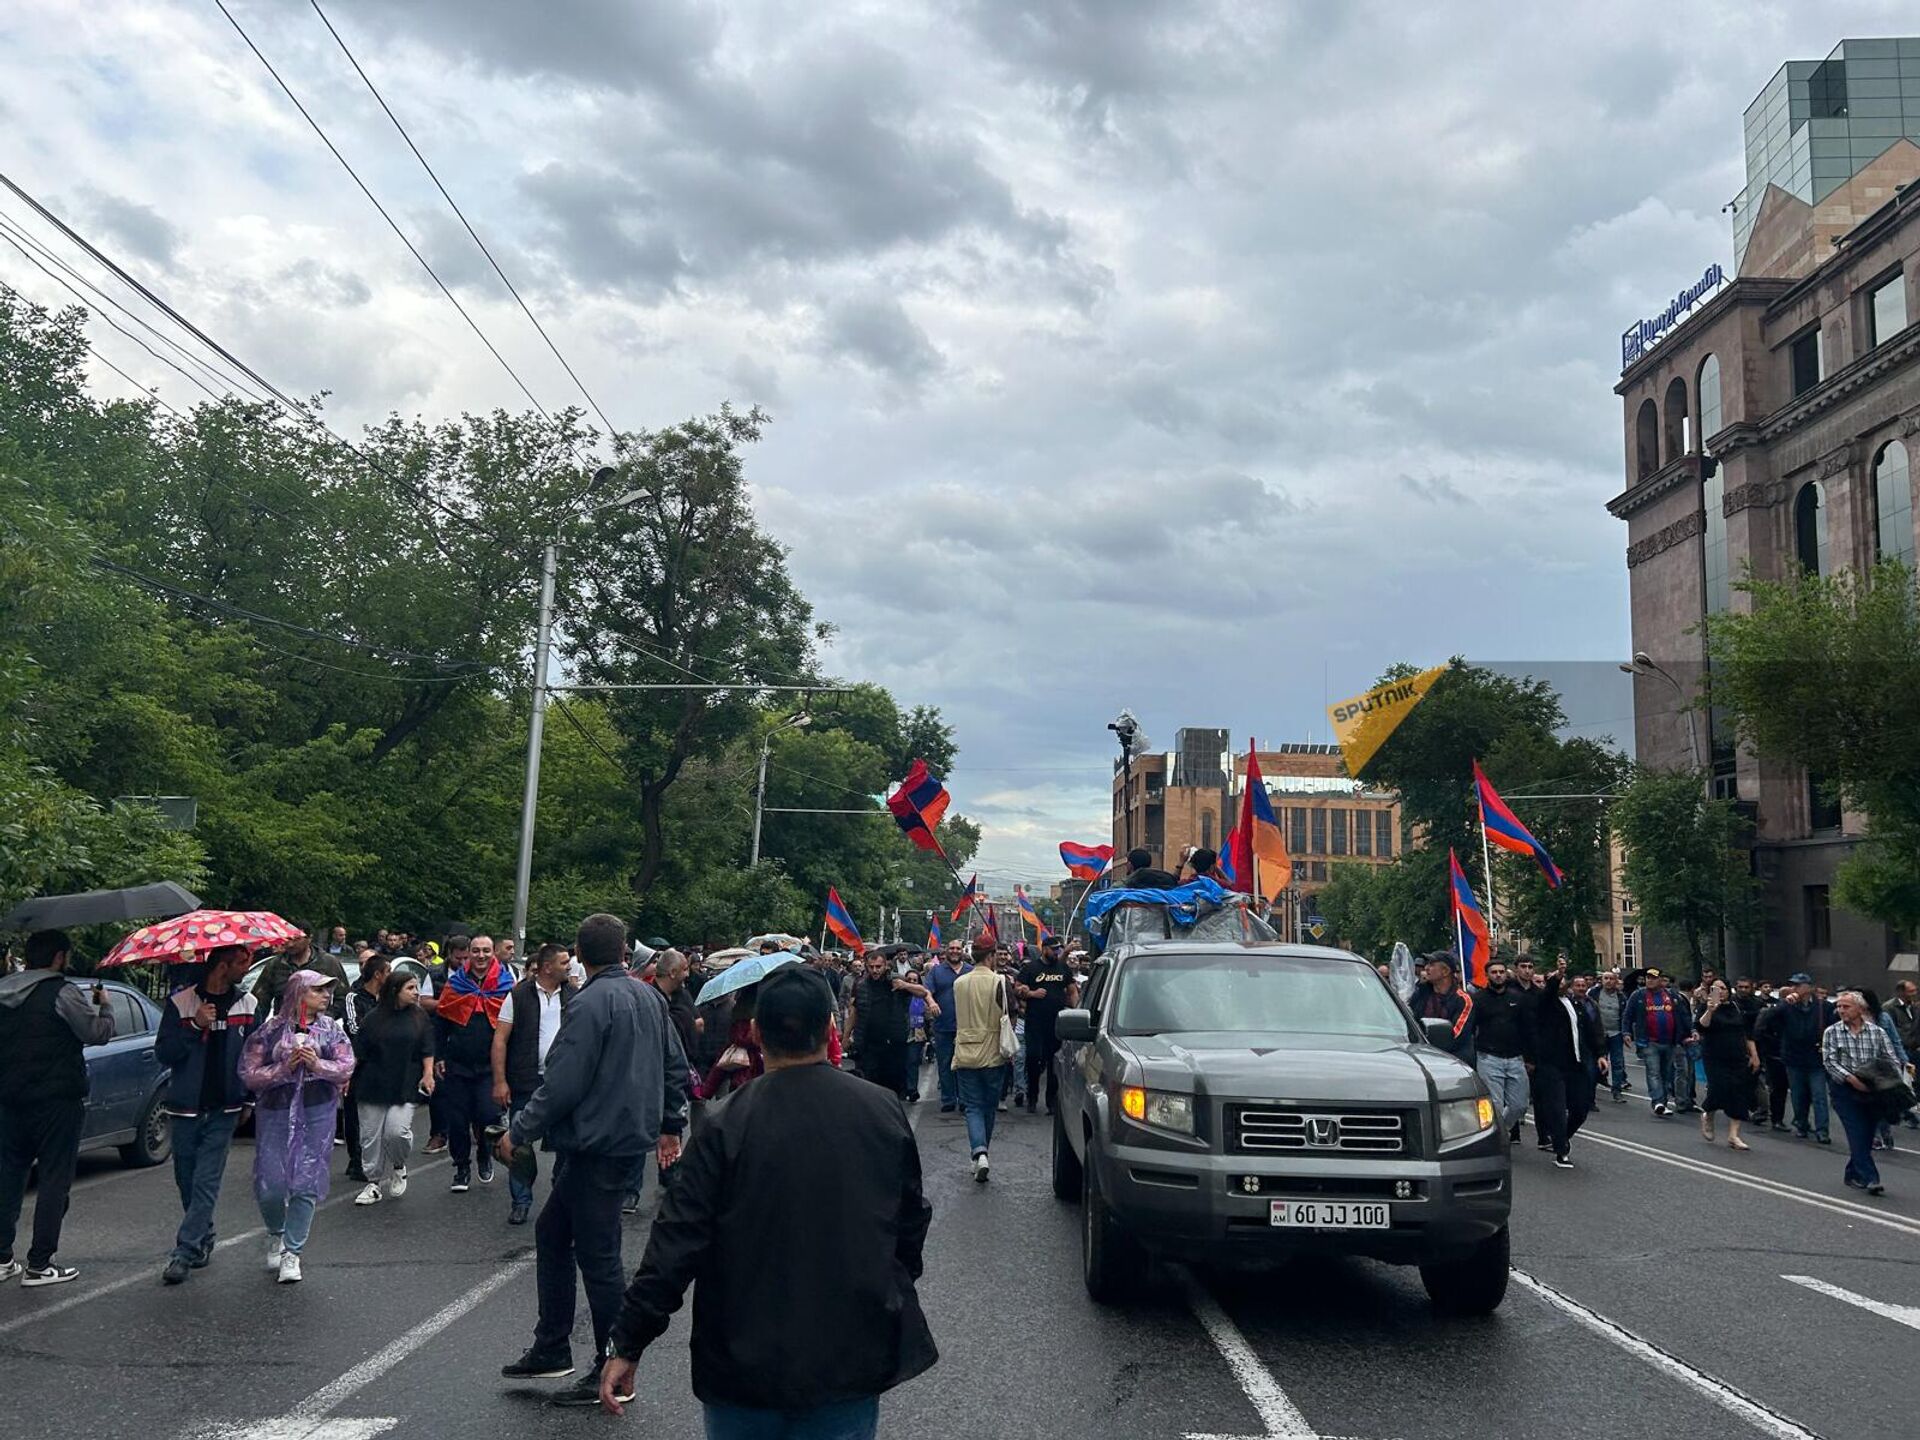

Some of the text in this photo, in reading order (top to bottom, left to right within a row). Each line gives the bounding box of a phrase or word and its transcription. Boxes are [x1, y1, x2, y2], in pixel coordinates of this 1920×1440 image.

[1272, 1214, 1286, 1223] AM
[1294, 1204, 1385, 1225] 60 JJ 100
